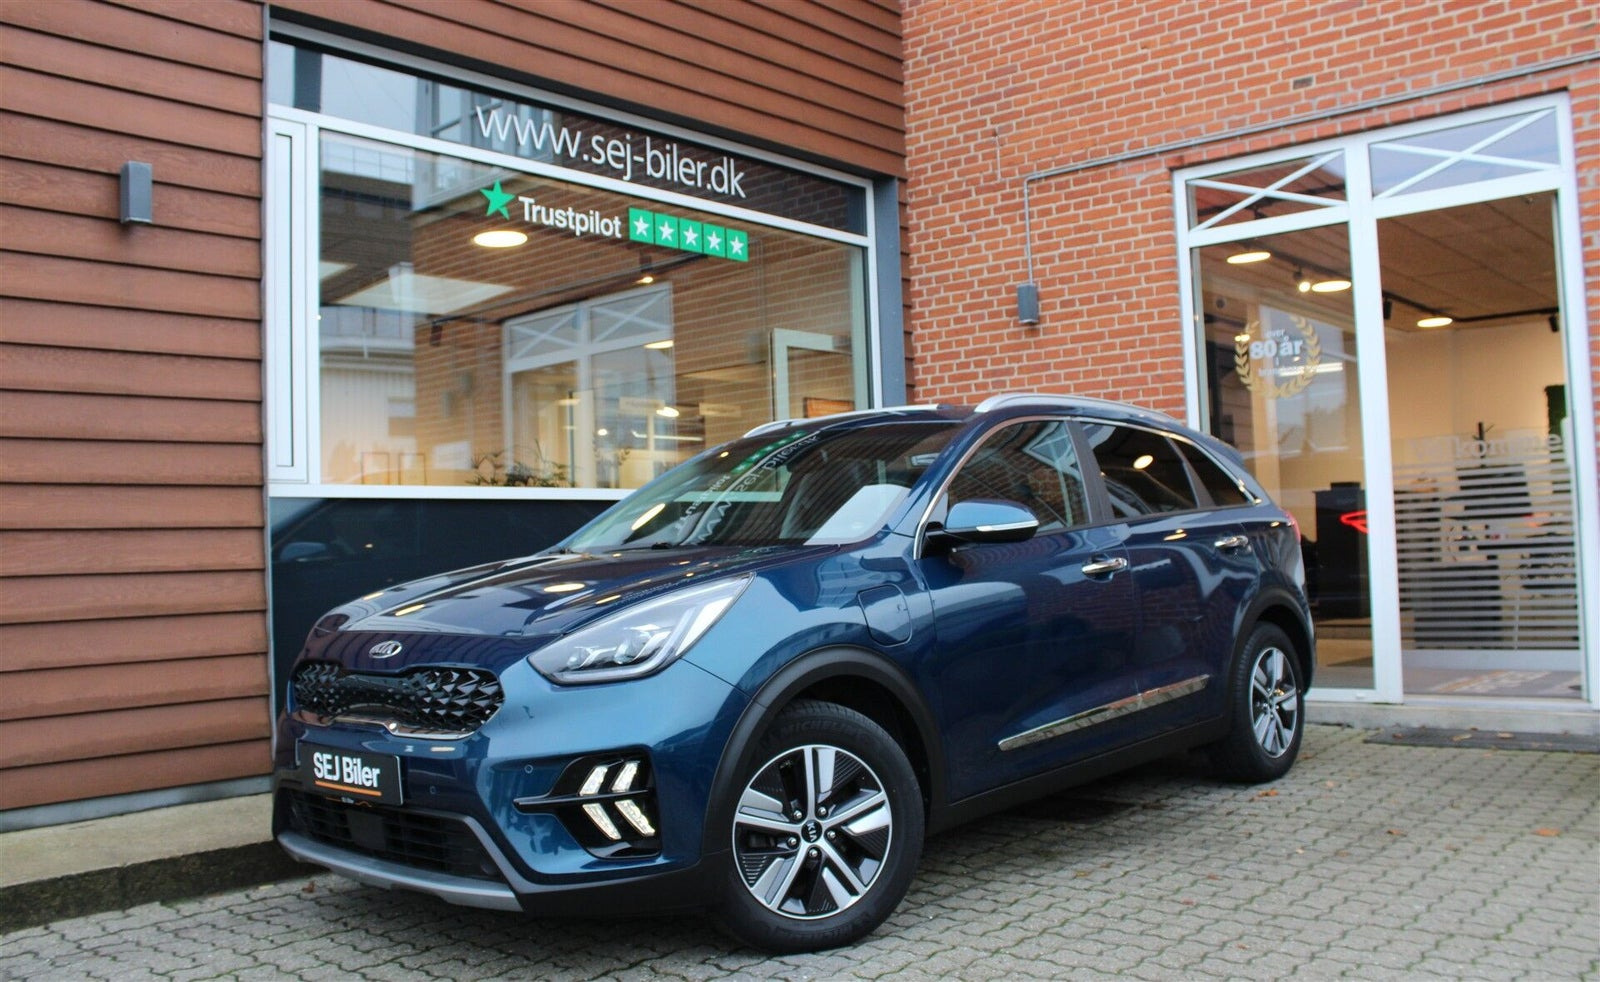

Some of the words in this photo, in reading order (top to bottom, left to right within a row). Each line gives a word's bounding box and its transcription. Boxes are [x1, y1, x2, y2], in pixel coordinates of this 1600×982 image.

[476, 105, 747, 199] www.sej-biler.dk
[518, 196, 622, 239] Trustpilot
[1249, 339, 1277, 360] 80
[313, 751, 341, 781] SEJ
[342, 755, 381, 788] Biler
[807, 822, 818, 842] KIA
